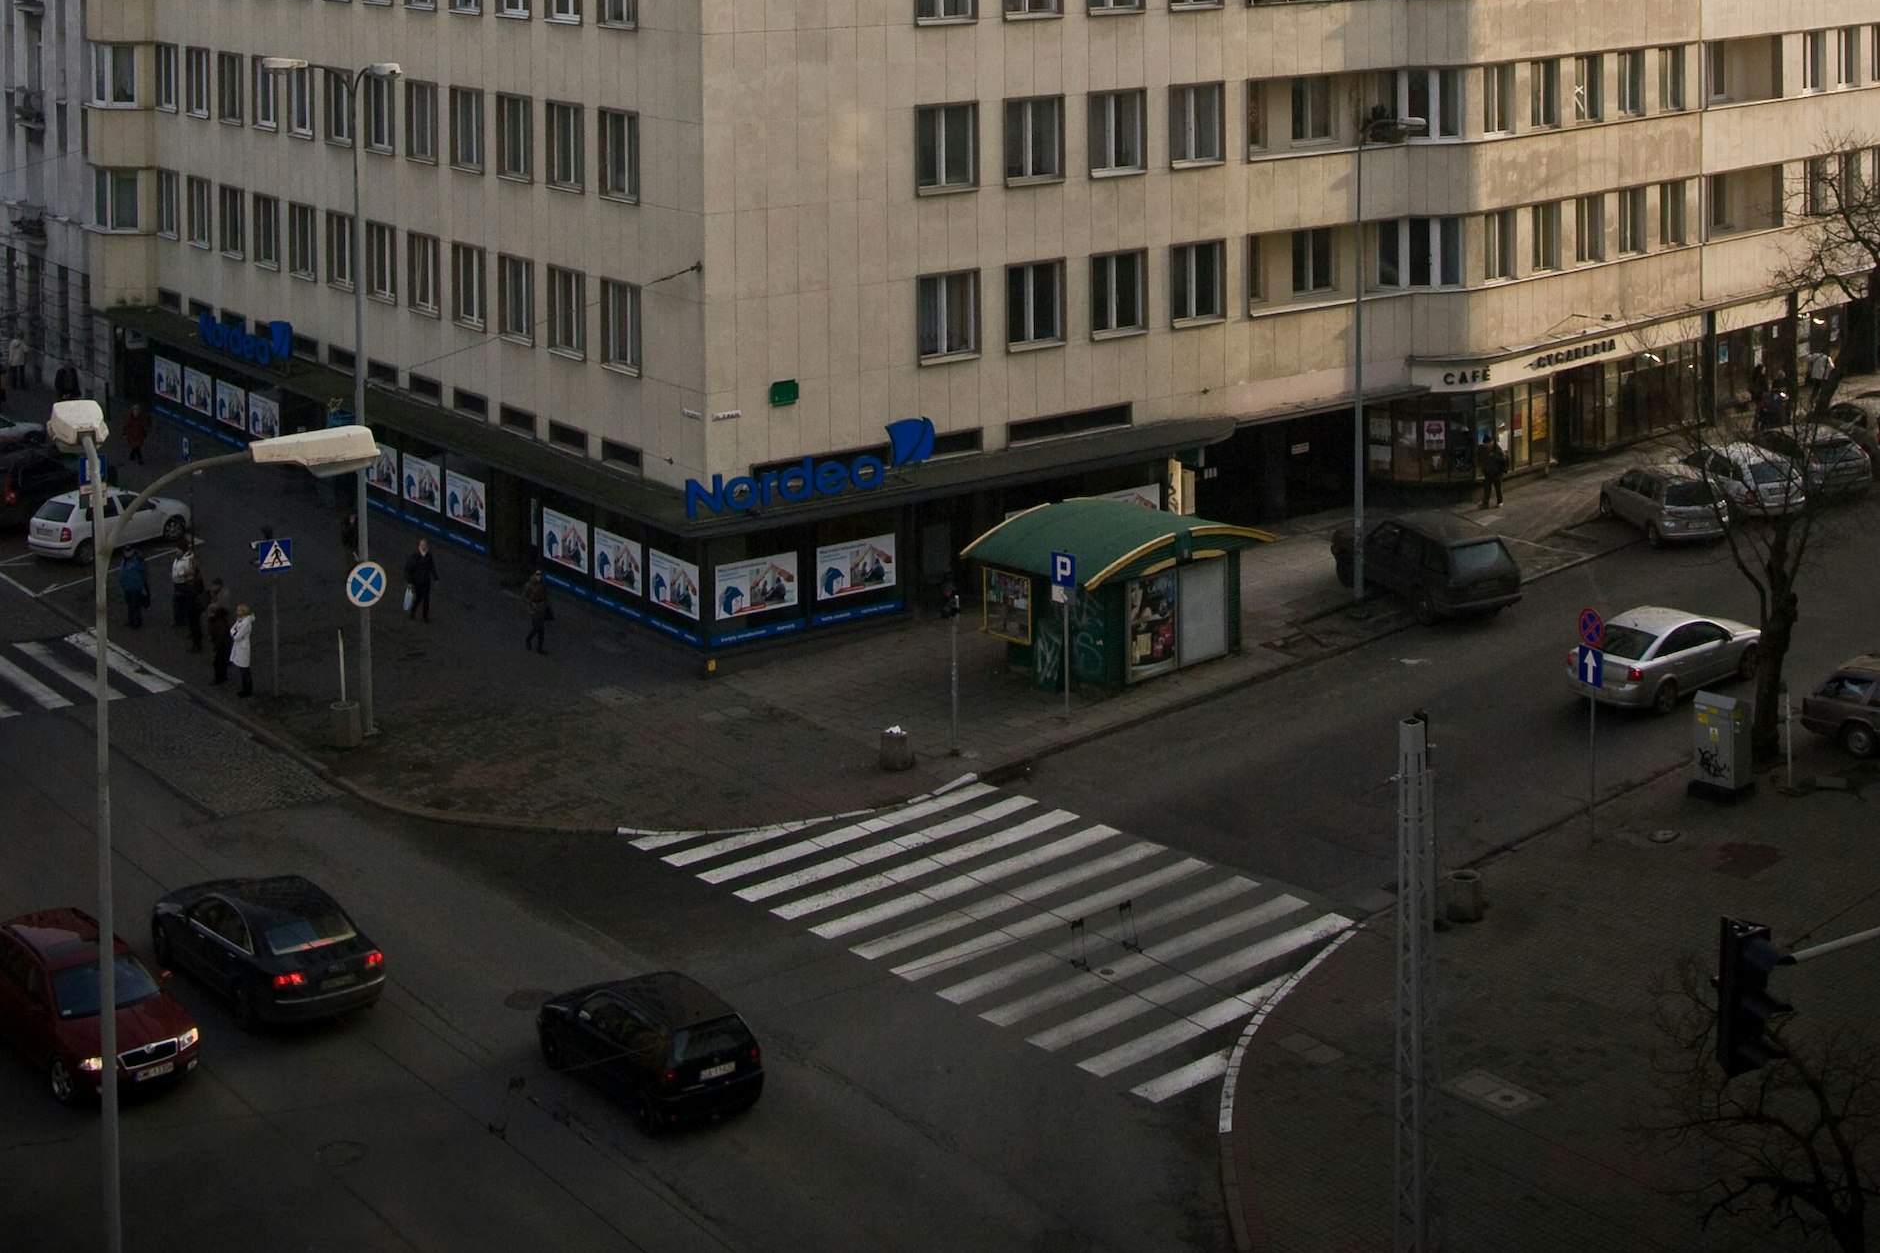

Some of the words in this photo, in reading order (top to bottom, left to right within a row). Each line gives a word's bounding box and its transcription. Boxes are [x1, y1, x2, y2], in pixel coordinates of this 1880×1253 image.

[198, 312, 271, 366] Nordea
[1443, 365, 1491, 386] CAFÉ
[684, 455, 885, 519] Nordea
[1056, 555, 1072, 582] P
